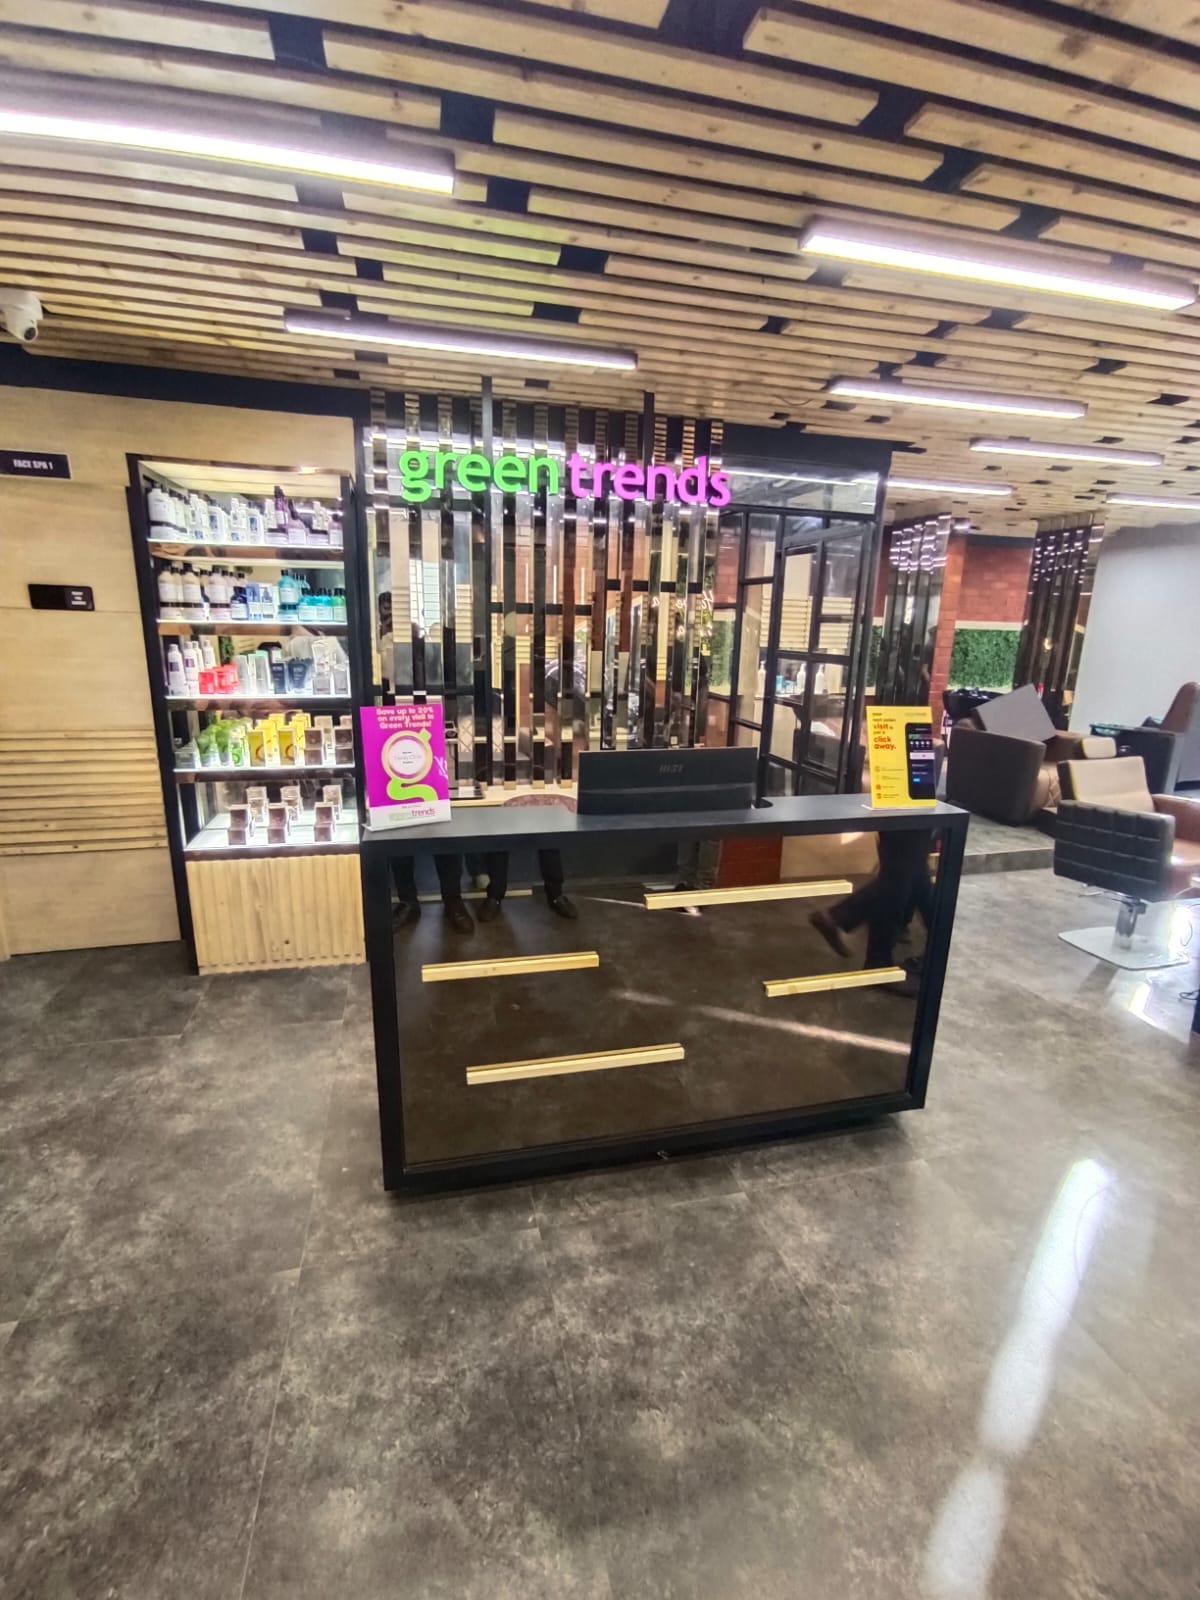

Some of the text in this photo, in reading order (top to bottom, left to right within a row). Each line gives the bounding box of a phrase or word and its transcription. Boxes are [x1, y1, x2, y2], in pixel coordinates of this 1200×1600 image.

[399, 450, 732, 507] green trends
[376, 708, 395, 716] Save
[397, 709, 407, 718] up
[389, 714, 410, 724] every
